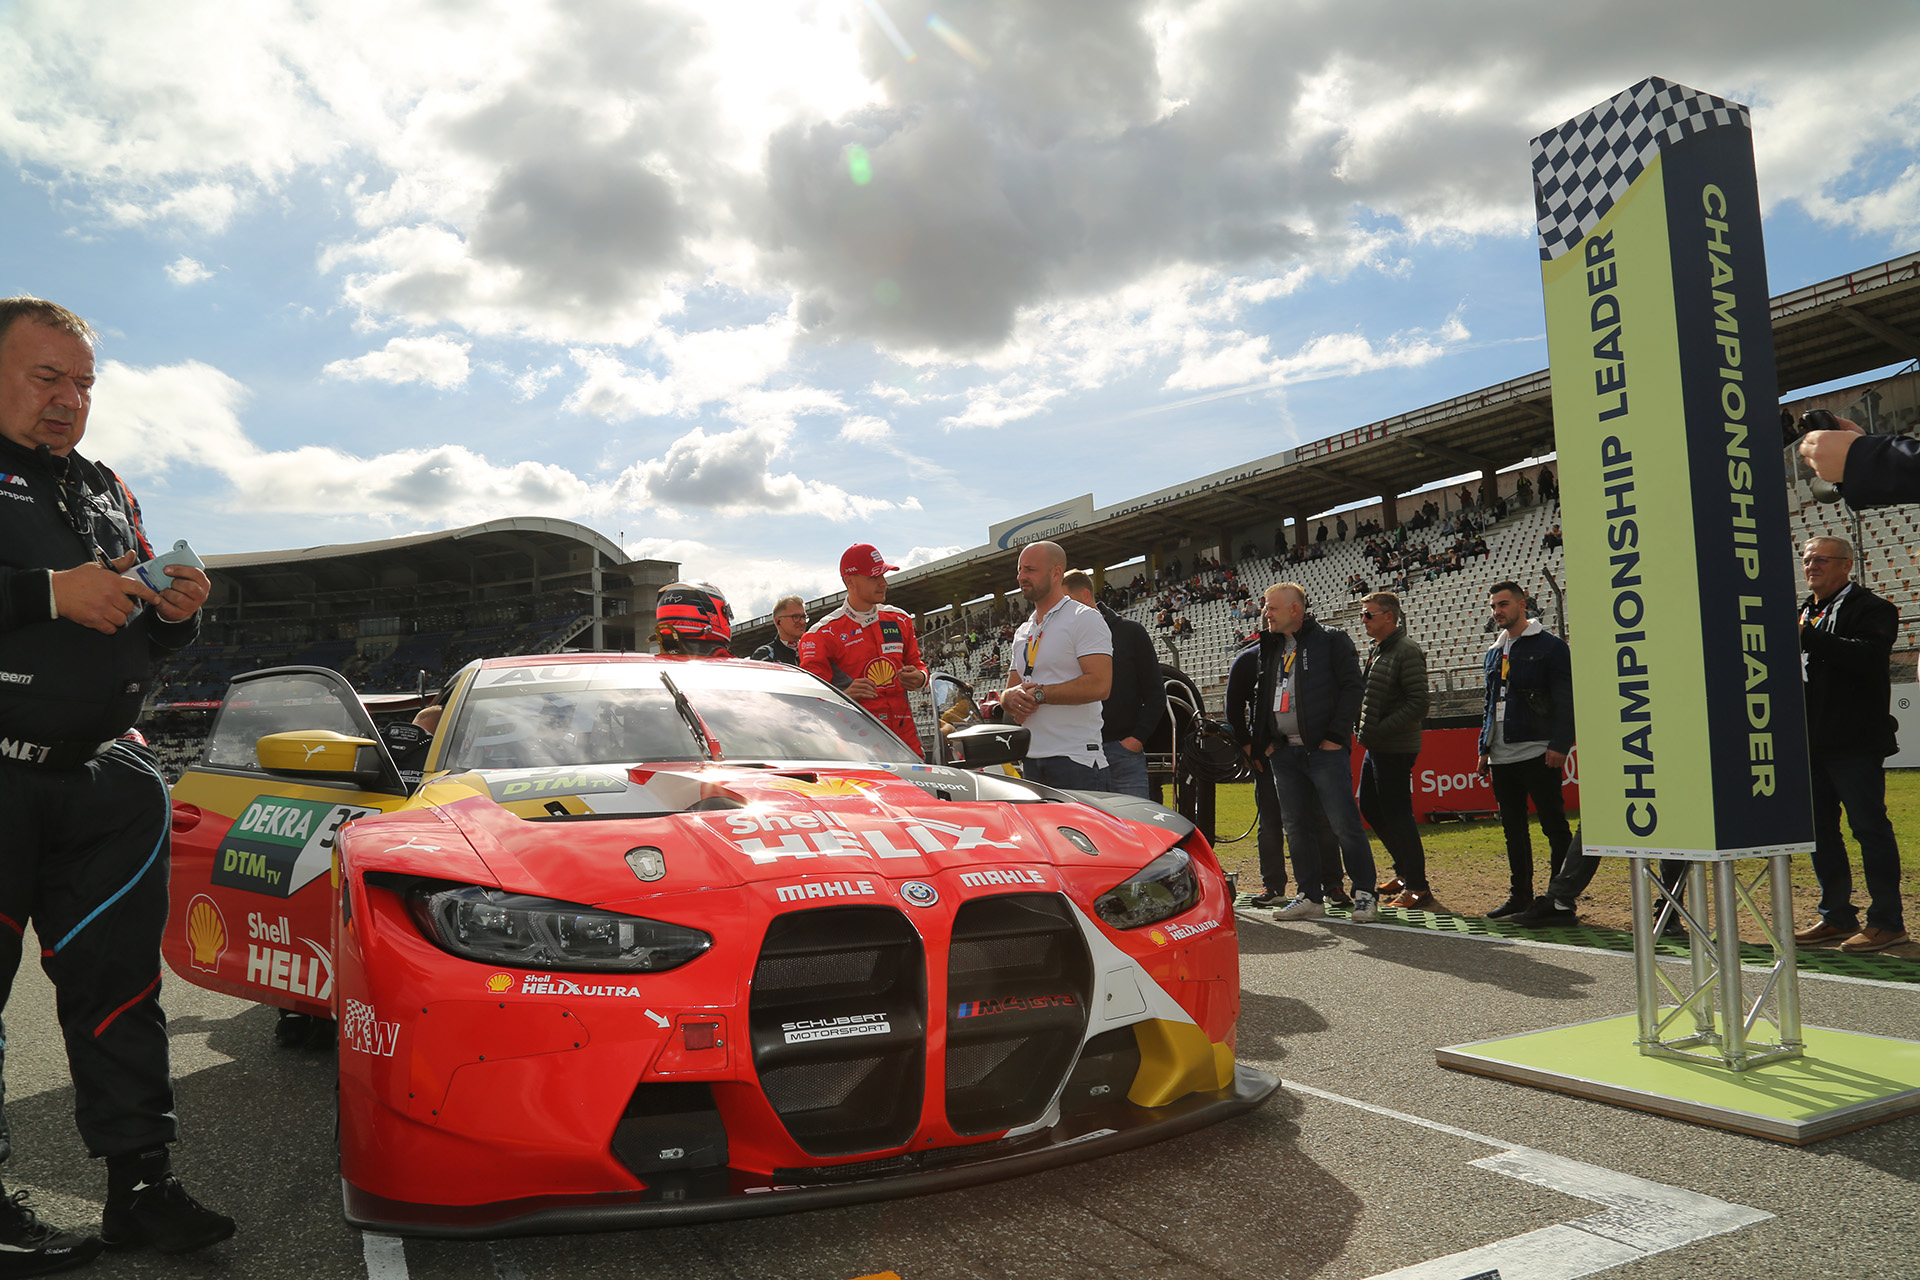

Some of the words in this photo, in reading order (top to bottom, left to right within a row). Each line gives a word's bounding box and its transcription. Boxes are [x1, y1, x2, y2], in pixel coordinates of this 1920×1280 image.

[1585, 229, 1630, 422] LEADER
[1703, 184, 1759, 579] CHAMPIONSHIP
[1739, 595, 1776, 797] LEADER
[1602, 435, 1658, 837] CHAMPIONSHIP
[502, 775, 587, 796] DTM
[590, 779, 616, 789] TV
[1420, 769, 1490, 797] Sport
[239, 803, 314, 840] DEKRA
[725, 809, 849, 836] Shell
[733, 816, 1022, 866] HELIX
[223, 848, 267, 879] DTM
[266, 869, 282, 885] TV
[959, 869, 1046, 888] MAHLE
[775, 880, 876, 903] MAHLE
[247, 912, 291, 946] Shell
[1164, 923, 1179, 933] Shell
[1169, 924, 1200, 942] HELIX
[1195, 919, 1220, 933] ULTRA
[521, 979, 583, 996] HELIX
[583, 985, 641, 998] ULTRA
[524, 974, 551, 983] Shell
[977, 996, 1028, 1016] M4
[1027, 994, 1078, 1009] GT3
[781, 1012, 888, 1032] SCHUBERT
[789, 1023, 886, 1042] MOTORSPORT
[351, 1018, 400, 1057] KW
